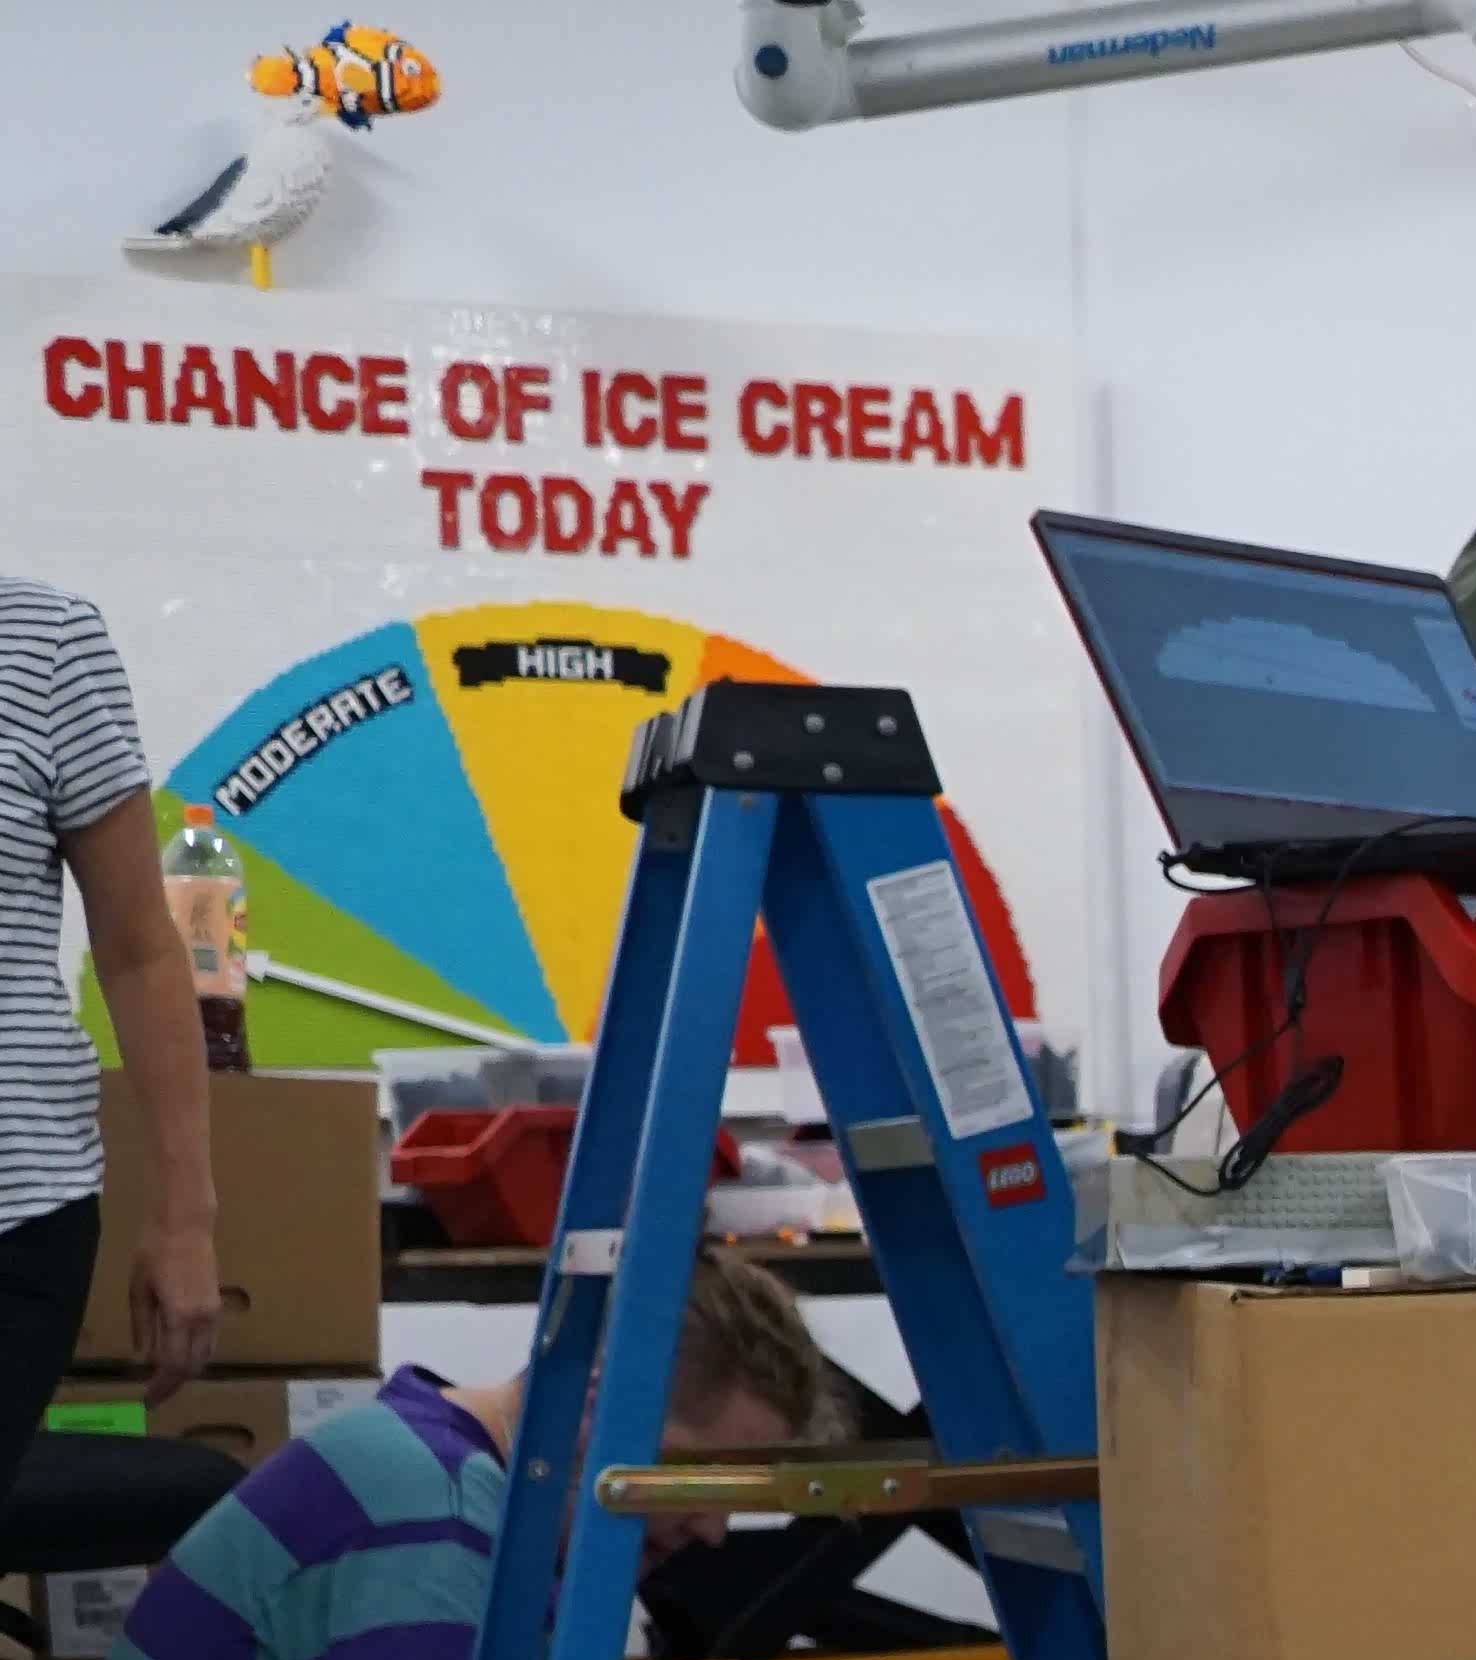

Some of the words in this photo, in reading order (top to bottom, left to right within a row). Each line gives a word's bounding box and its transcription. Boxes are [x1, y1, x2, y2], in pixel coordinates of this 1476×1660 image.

[43, 336, 407, 435] CHANCE
[441, 361, 551, 443] OF
[582, 367, 711, 452] ICE
[737, 381, 1027, 469] CREAM
[421, 469, 712, 559] TODAY
[516, 644, 614, 681] HIGH
[213, 667, 412, 816] MODERATE
[988, 1161, 1036, 1191] LEGO
